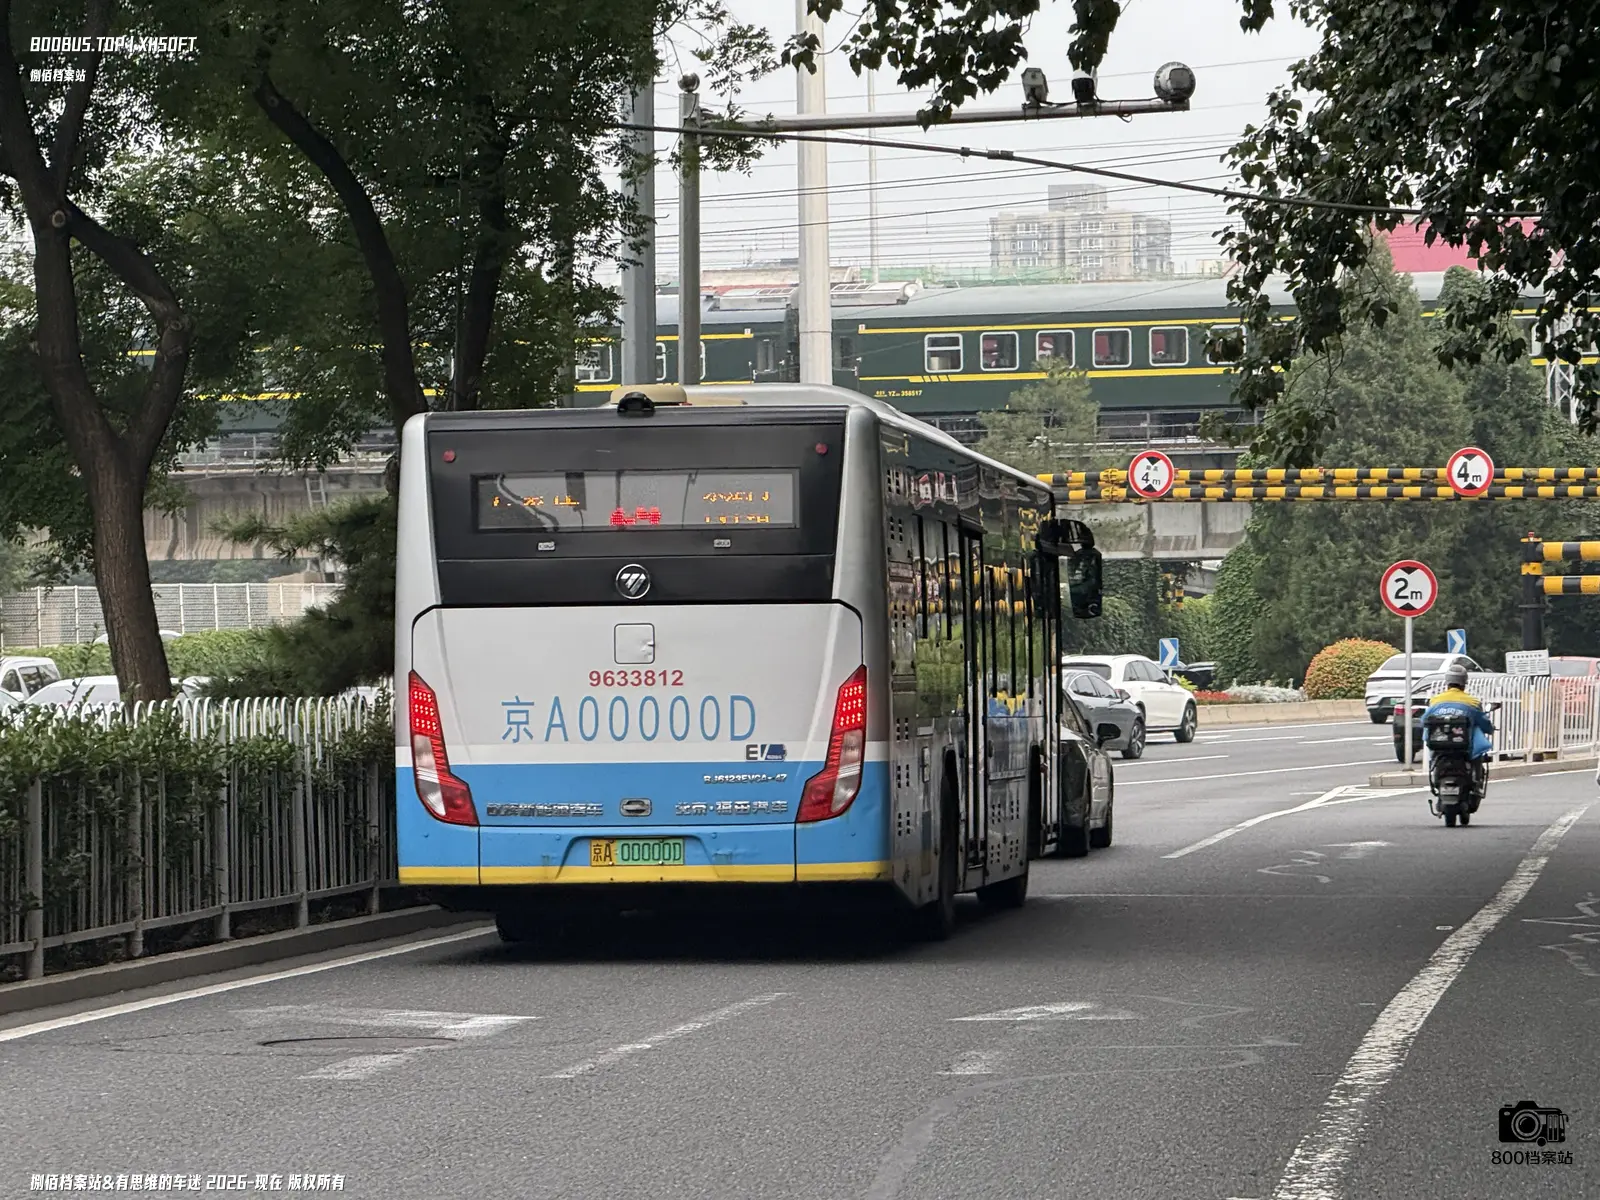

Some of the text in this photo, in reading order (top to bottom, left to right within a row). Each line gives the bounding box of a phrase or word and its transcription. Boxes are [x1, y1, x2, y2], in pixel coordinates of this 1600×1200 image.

[1457, 461, 1482, 482] 4m
[1394, 577, 1423, 600] 2m
[588, 669, 684, 687] 9633812
[501, 695, 756, 743] 京A00000D
